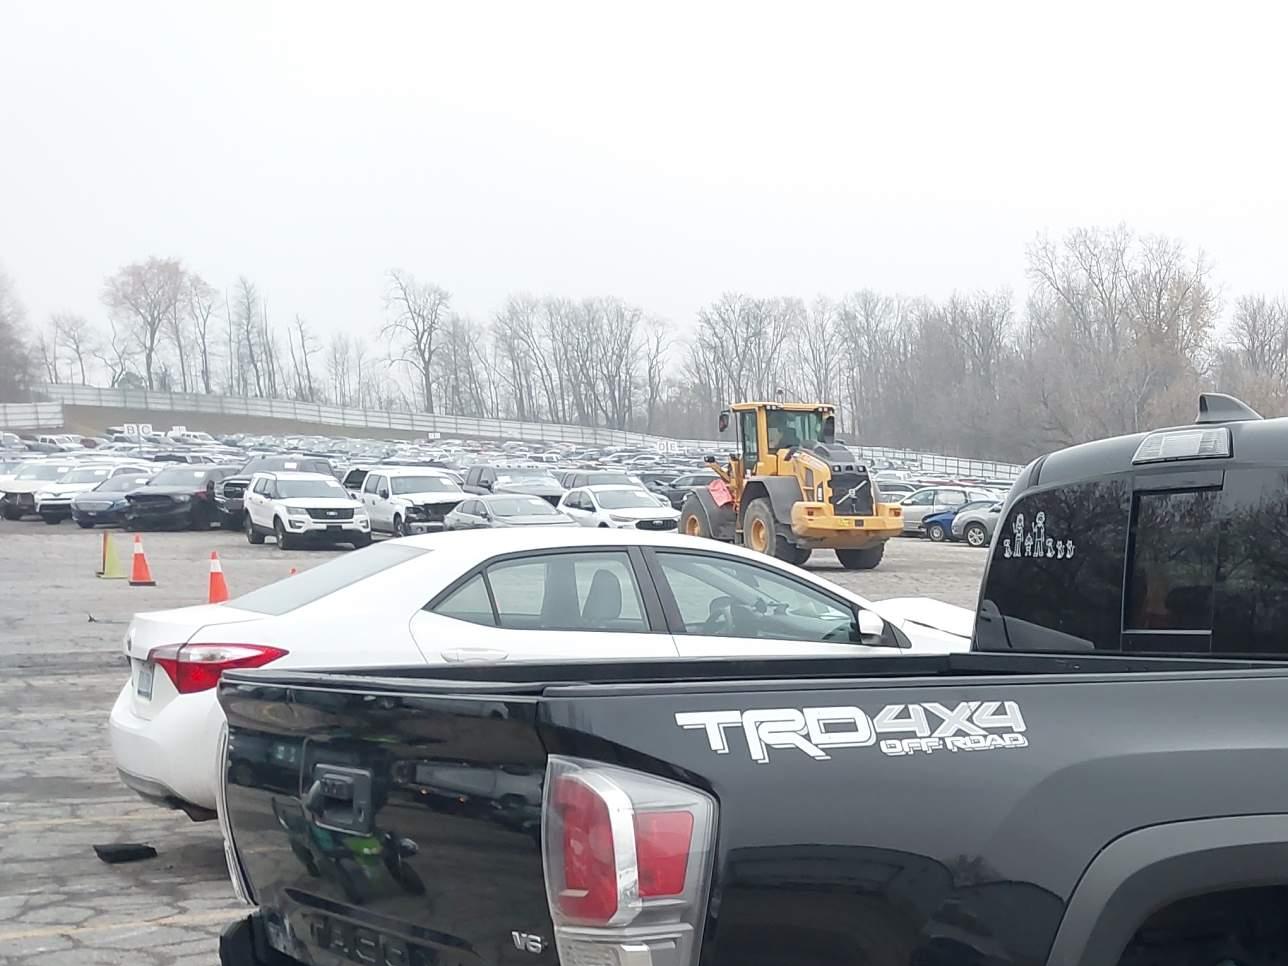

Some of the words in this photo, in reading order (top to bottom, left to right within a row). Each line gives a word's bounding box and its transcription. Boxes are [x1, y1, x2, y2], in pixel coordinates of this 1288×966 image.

[141, 424, 151, 435] C
[674, 706, 877, 763] TRD
[879, 737, 944, 757] OFF
[946, 733, 1030, 753] ROAD
[511, 930, 543, 955] V6
